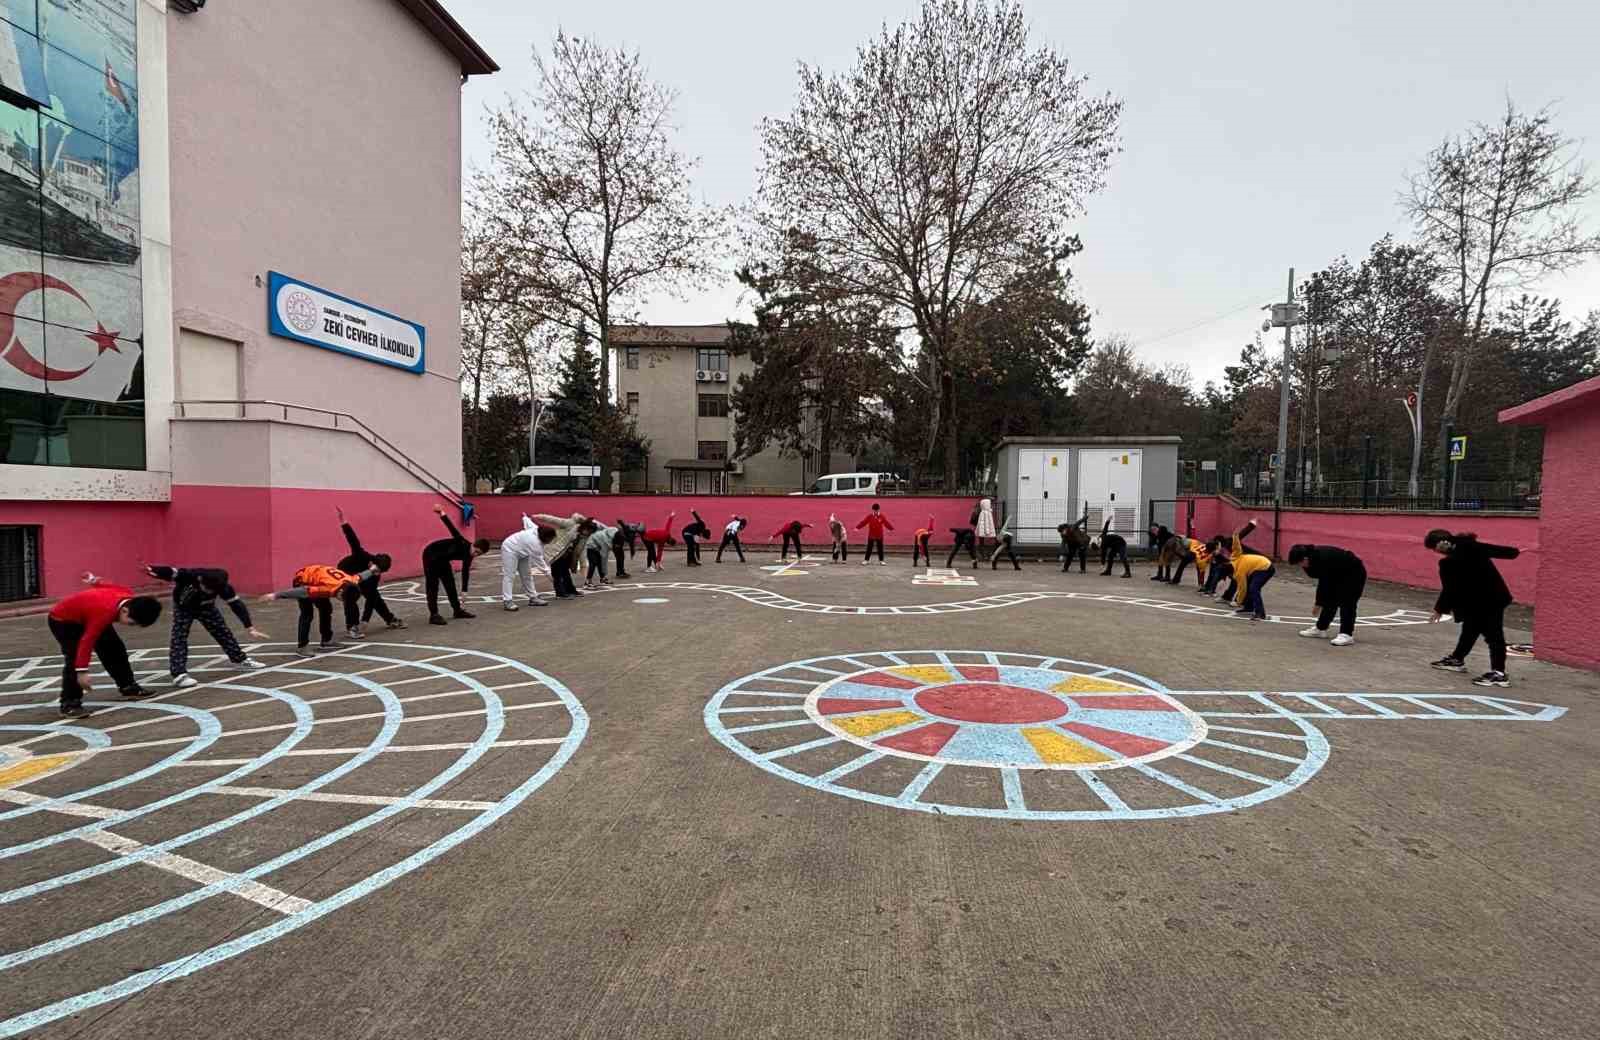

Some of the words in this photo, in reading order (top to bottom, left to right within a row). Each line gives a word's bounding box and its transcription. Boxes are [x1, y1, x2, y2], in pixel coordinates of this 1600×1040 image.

[323, 318, 344, 337] ZEKİ
[346, 325, 378, 348] CEVHER
[380, 333, 415, 358] İLKOKULU
